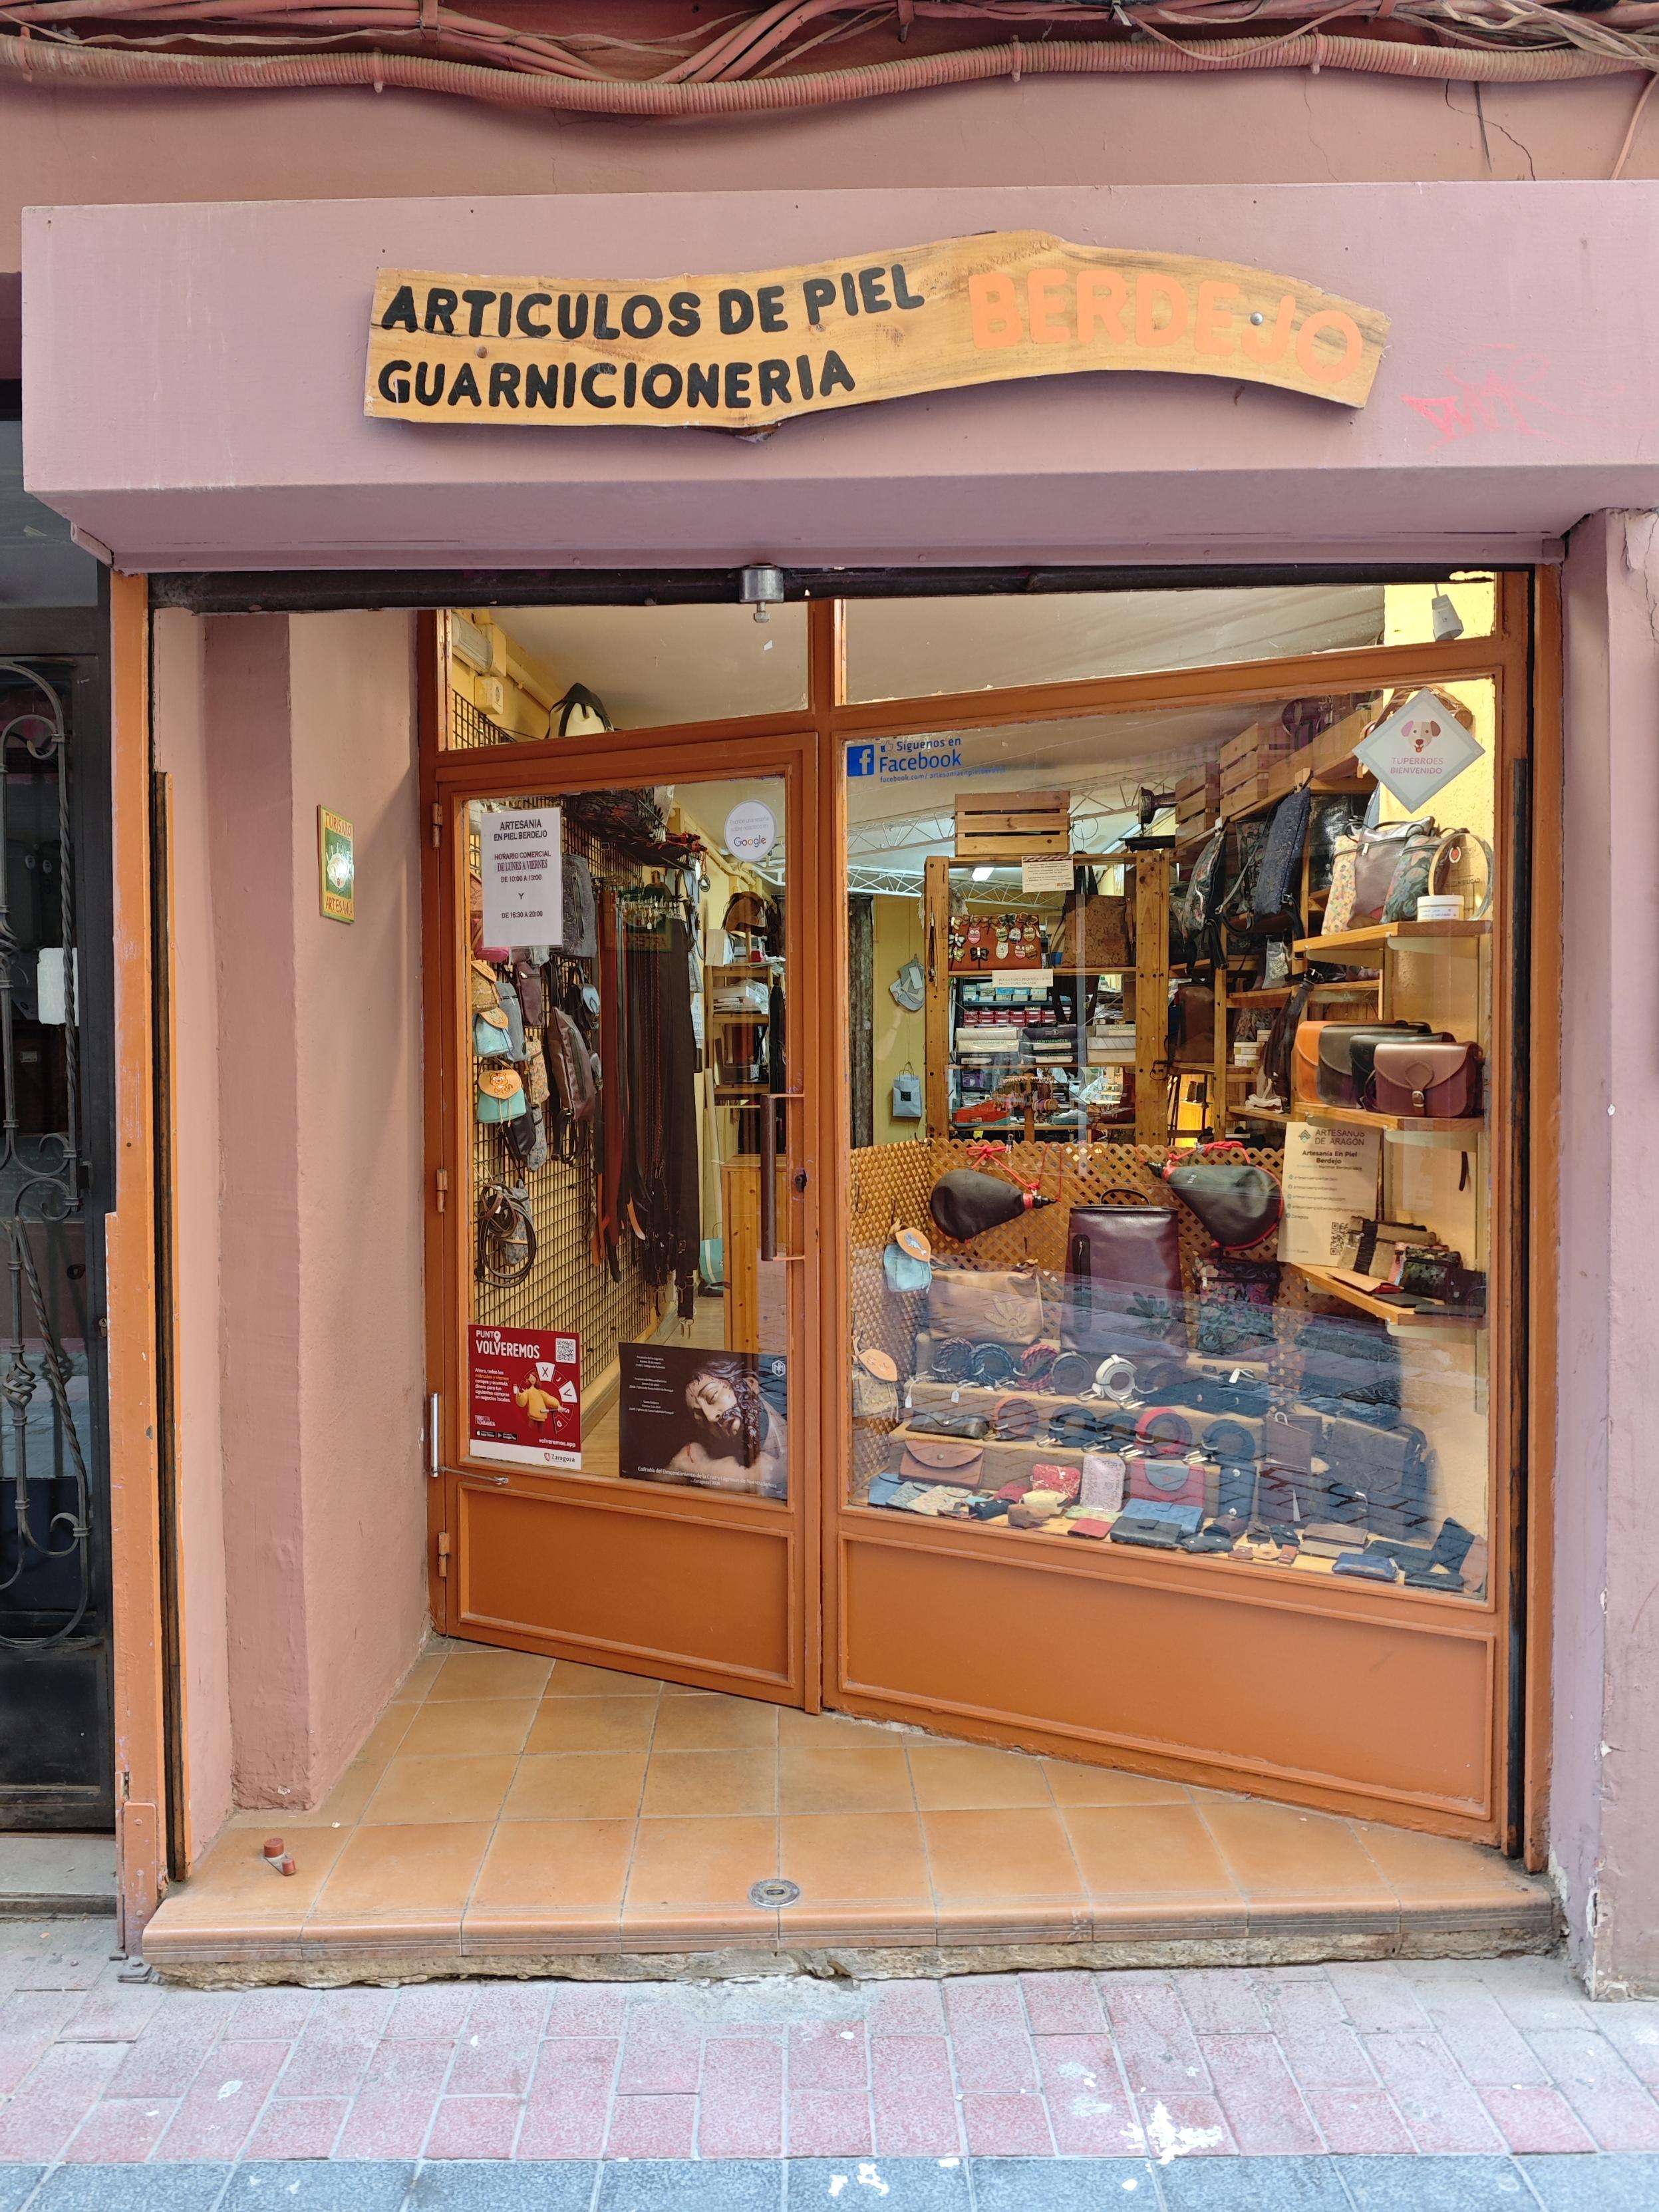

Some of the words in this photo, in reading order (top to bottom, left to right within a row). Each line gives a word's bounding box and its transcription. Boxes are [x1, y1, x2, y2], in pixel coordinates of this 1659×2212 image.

[381, 285, 700, 340] ARTICULOS
[718, 285, 788, 335] DE
[804, 263, 925, 326] PIEL
[968, 269, 1363, 383] BERDEJO
[378, 350, 855, 408] GUARNICIONERIA
[879, 749, 962, 773] Facebook
[325, 812, 352, 837] TURISMO
[500, 819, 542, 831] ARTESANIA
[494, 833, 503, 842] EN
[504, 832, 518, 841] PIEL
[518, 830, 547, 840] BERDEJO
[734, 834, 766, 848] Google
[520, 850, 551, 859] COMERCIAL
[497, 863, 505, 871] DE
[506, 862, 522, 871] LUNES
[527, 859, 547, 870] VIERNES
[476, 1340, 540, 1359] VOLVEREMOS
[538, 1438, 576, 1448] volveremos.app
[551, 1454, 575, 1463] Zaragoza
